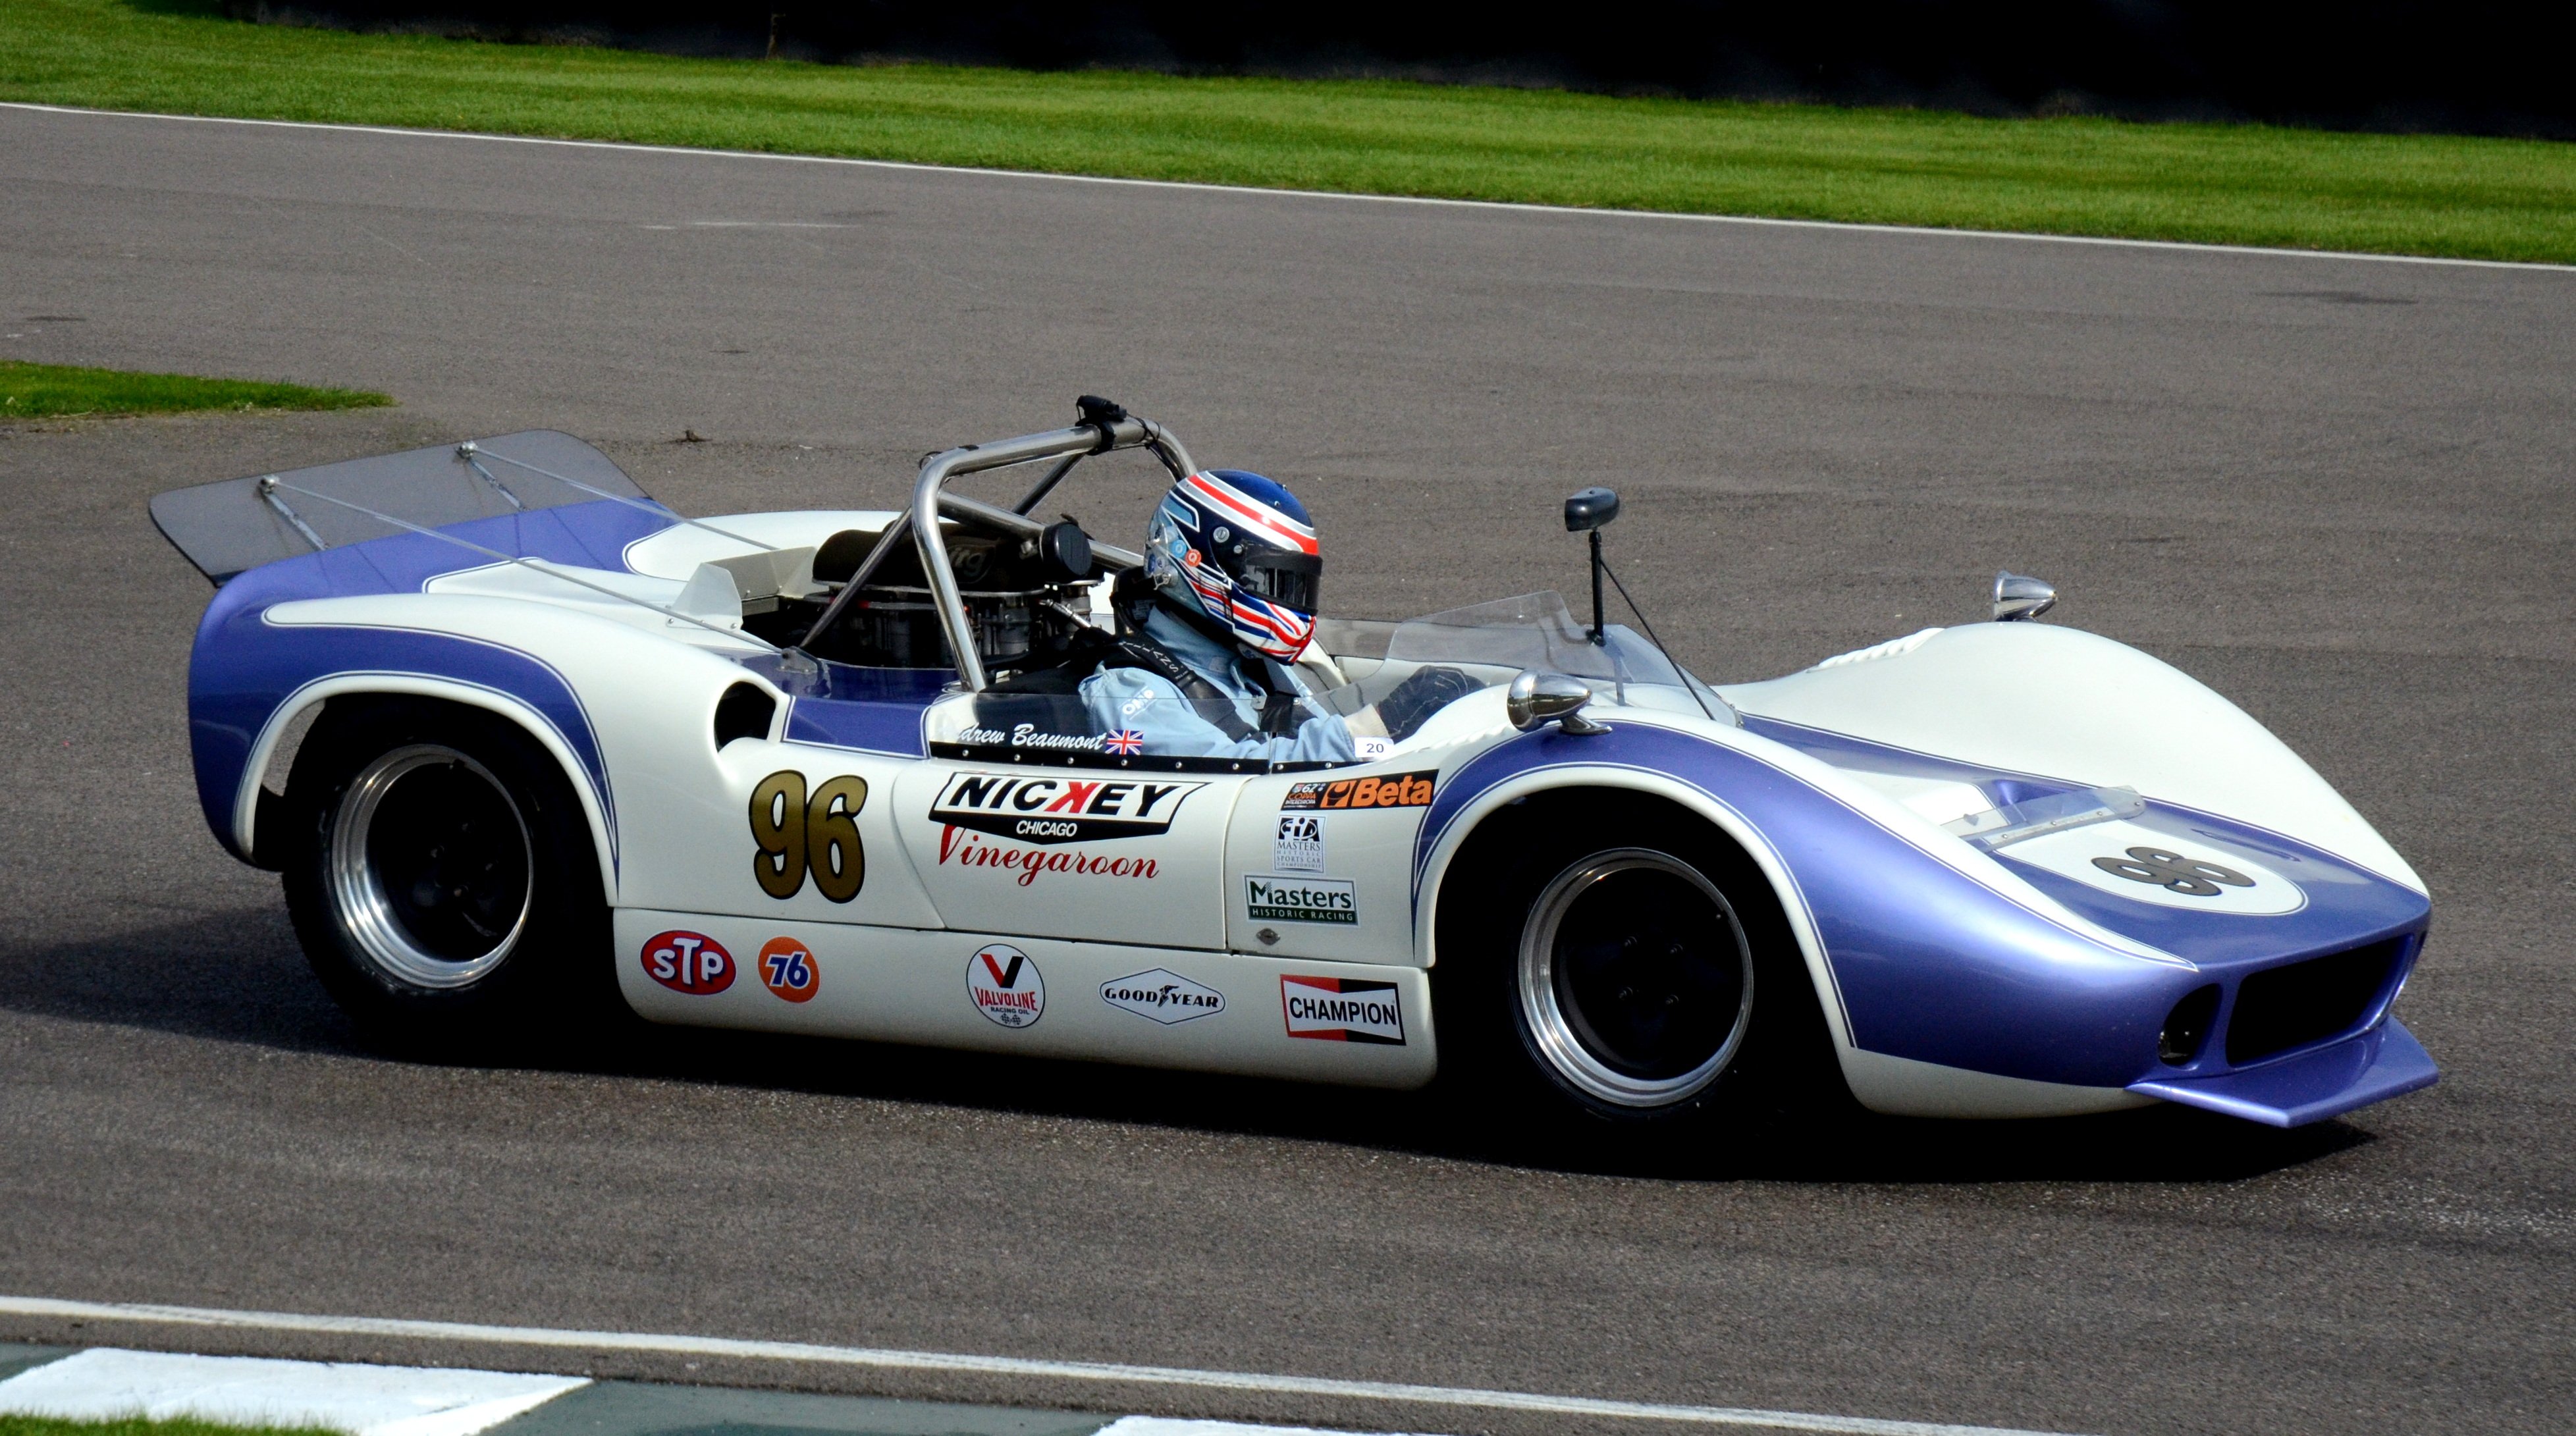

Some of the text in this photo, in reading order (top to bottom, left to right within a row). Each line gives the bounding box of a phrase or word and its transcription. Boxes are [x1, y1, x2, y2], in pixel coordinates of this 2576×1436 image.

[1012, 723, 1108, 750] Beaumont
[1366, 743, 1384, 753] 20
[948, 776, 1181, 818] NICKEY
[1351, 775, 1433, 807] Beta
[749, 769, 869, 904] 96
[1016, 820, 1077, 838] CHICAGO
[939, 824, 1160, 887] Vinegaroon
[1277, 841, 1321, 851] MASTERS
[1250, 880, 1352, 909] Masters
[1252, 908, 1354, 920] HISTORIC RACING
[653, 937, 725, 986] STP
[765, 951, 811, 990] 76
[974, 986, 1038, 1012] VALVOLINE
[1289, 996, 1397, 1026] CHAMPION
